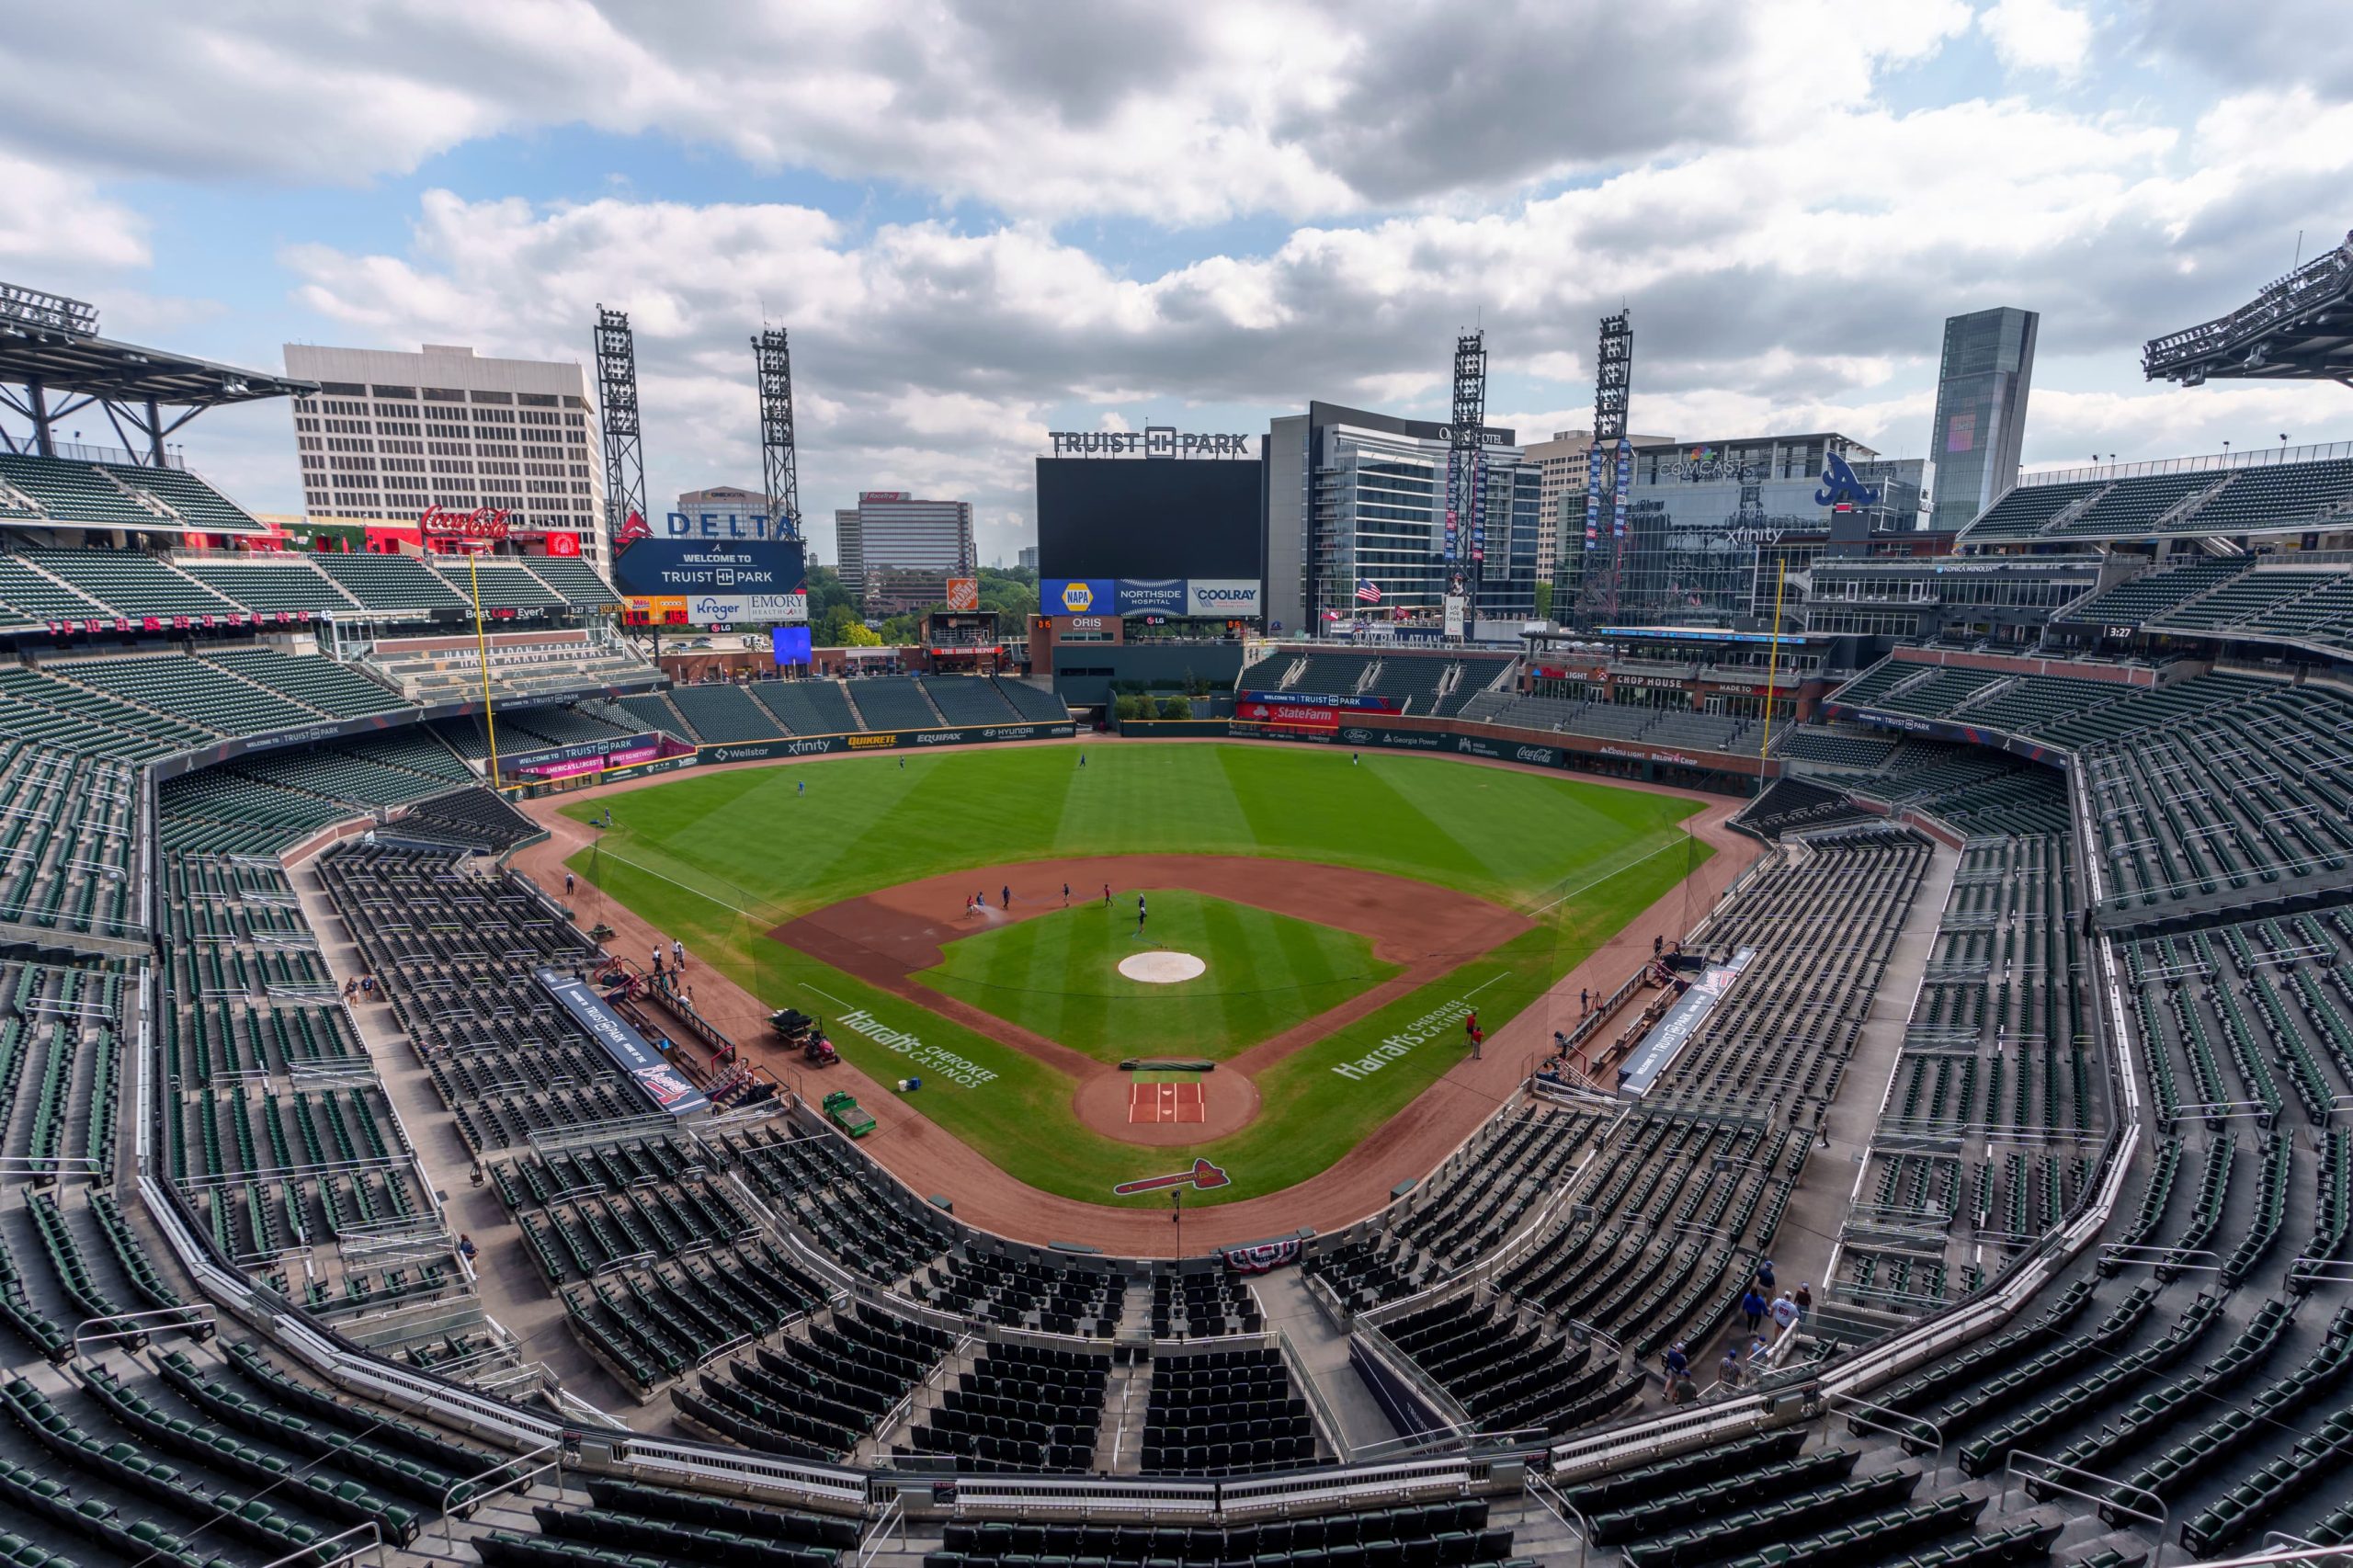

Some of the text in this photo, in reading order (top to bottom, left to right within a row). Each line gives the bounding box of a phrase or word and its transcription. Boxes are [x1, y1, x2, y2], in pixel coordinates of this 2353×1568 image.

[1048, 432, 1248, 454] TRUIST PARK
[1659, 460, 1744, 477] COMCAST
[420, 504, 512, 537] Coca-Cola
[666, 512, 798, 540] DELTA
[1725, 526, 1784, 545] xfinity
[683, 554, 735, 562] WELCOME
[662, 572, 772, 582] TRUIST PARK
[1066, 590, 1089, 604] NAPA
[1198, 589, 1256, 600] COOLRAY
[697, 597, 740, 620] Kroger
[751, 596, 803, 608] EMORY
[491, 608, 516, 619] Coke
[517, 608, 544, 617] Ever?
[63, 619, 74, 634] 6
[83, 619, 101, 632] 10
[115, 618, 131, 631] 21
[201, 615, 215, 627] 31
[251, 613, 264, 625] 41
[277, 612, 290, 623] 44
[297, 611, 309, 621] 47
[321, 610, 333, 621] 42
[1073, 618, 1101, 627] ORIS
[2110, 627, 2131, 638] 3:27
[1565, 671, 1587, 679] LIGHT
[1617, 676, 1682, 688] CHOP HOUSE
[532, 695, 553, 704] TRUIST
[1301, 695, 1328, 704] TRUIST
[1339, 697, 1360, 705] PARK
[998, 727, 1034, 735] HYUNDAI
[1885, 717, 1905, 726] TRUIST
[1914, 722, 1929, 731] PARK
[245, 740, 271, 748] WELCOME
[283, 731, 310, 742] TRUIST
[321, 726, 338, 735] PARK
[848, 735, 897, 745] QUIKRETE
[917, 733, 961, 744] EQUIFAX
[1393, 736, 1438, 746] Georgia Power
[518, 755, 551, 765] WELCOME
[565, 745, 597, 757] TRUIST
[610, 740, 631, 751] PARK
[730, 747, 768, 757] Wellstar
[788, 739, 830, 755] xfinity
[1652, 753, 1673, 762] BELOW
[1680, 757, 1698, 766] CHOP
[546, 762, 575, 773] AMERICA'S
[1407, 999, 1467, 1031] CHEROKEE
[1421, 1003, 1480, 1038] CASINOS
[585, 1006, 607, 1026] TRUIST
[605, 1027, 628, 1043] PARK
[836, 1009, 922, 1053] Harrah's
[1652, 1032, 1677, 1052] TRUIST
[1675, 1012, 1694, 1029] PARK
[925, 1045, 999, 1082] CHEROKEE
[1331, 1034, 1425, 1081] Harrah's
[908, 1051, 982, 1089] CASINOS
[1406, 1402, 1432, 1433] TRUIST
